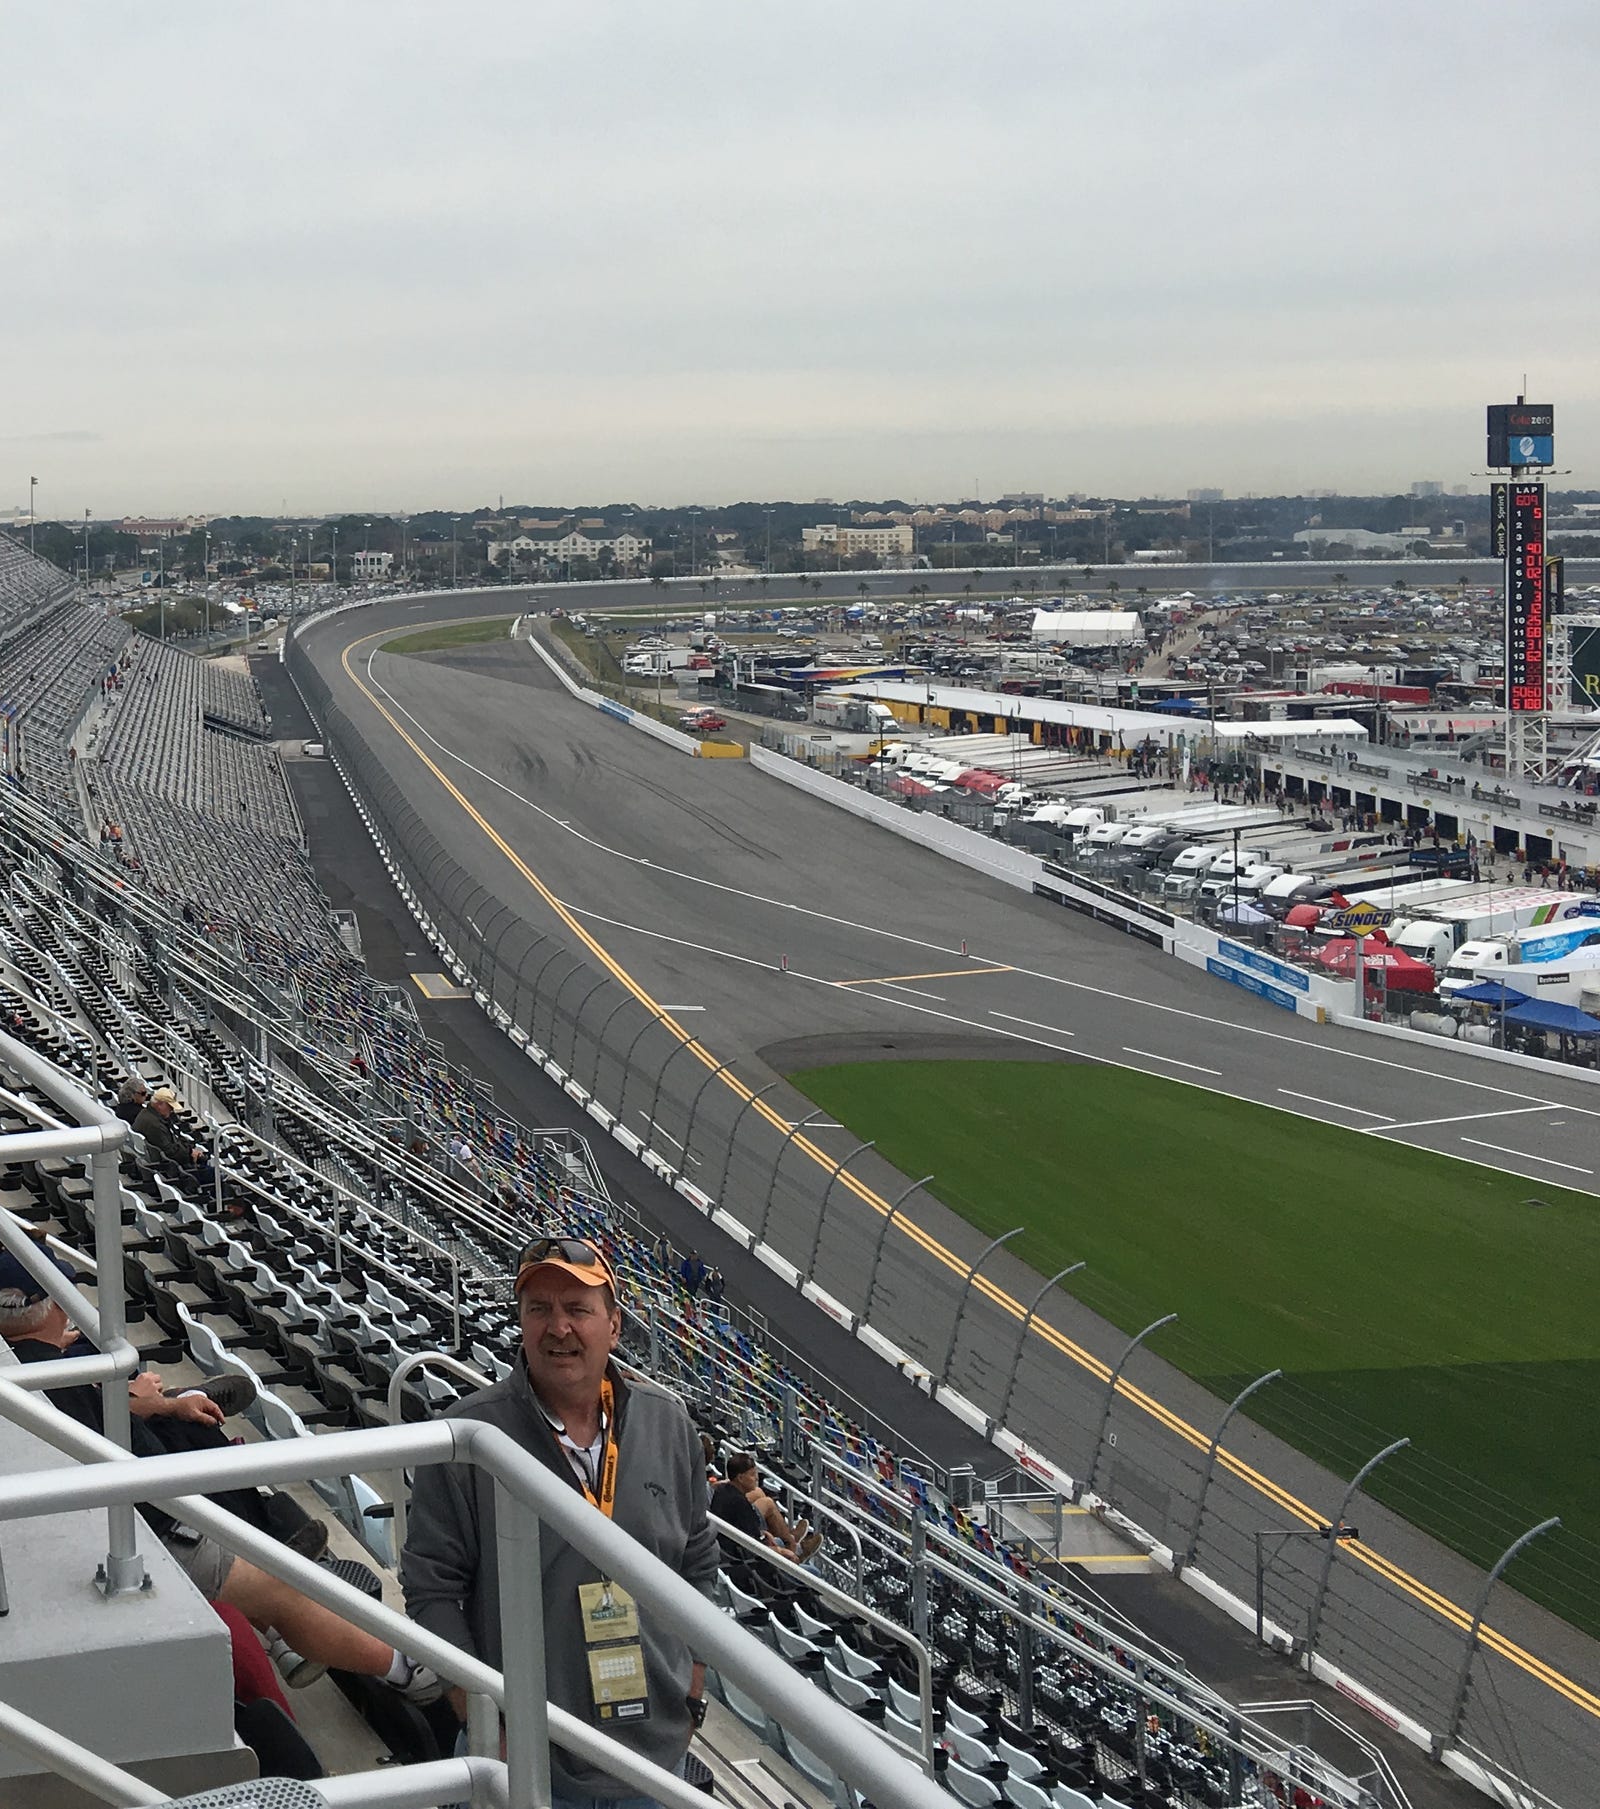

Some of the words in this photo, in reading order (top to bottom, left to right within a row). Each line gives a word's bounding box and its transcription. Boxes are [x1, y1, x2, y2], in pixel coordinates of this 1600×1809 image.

[1531, 416, 1551, 424] zero
[1497, 496, 1505, 519] Sprint
[1533, 508, 1542, 518] 5
[1497, 533, 1505, 557] Sprint
[1526, 543, 1542, 554] 90
[1526, 555, 1542, 566] 01
[1526, 567, 1542, 578] 02
[1527, 639, 1541, 650] 31
[1334, 912, 1391, 927] SUNOCO
